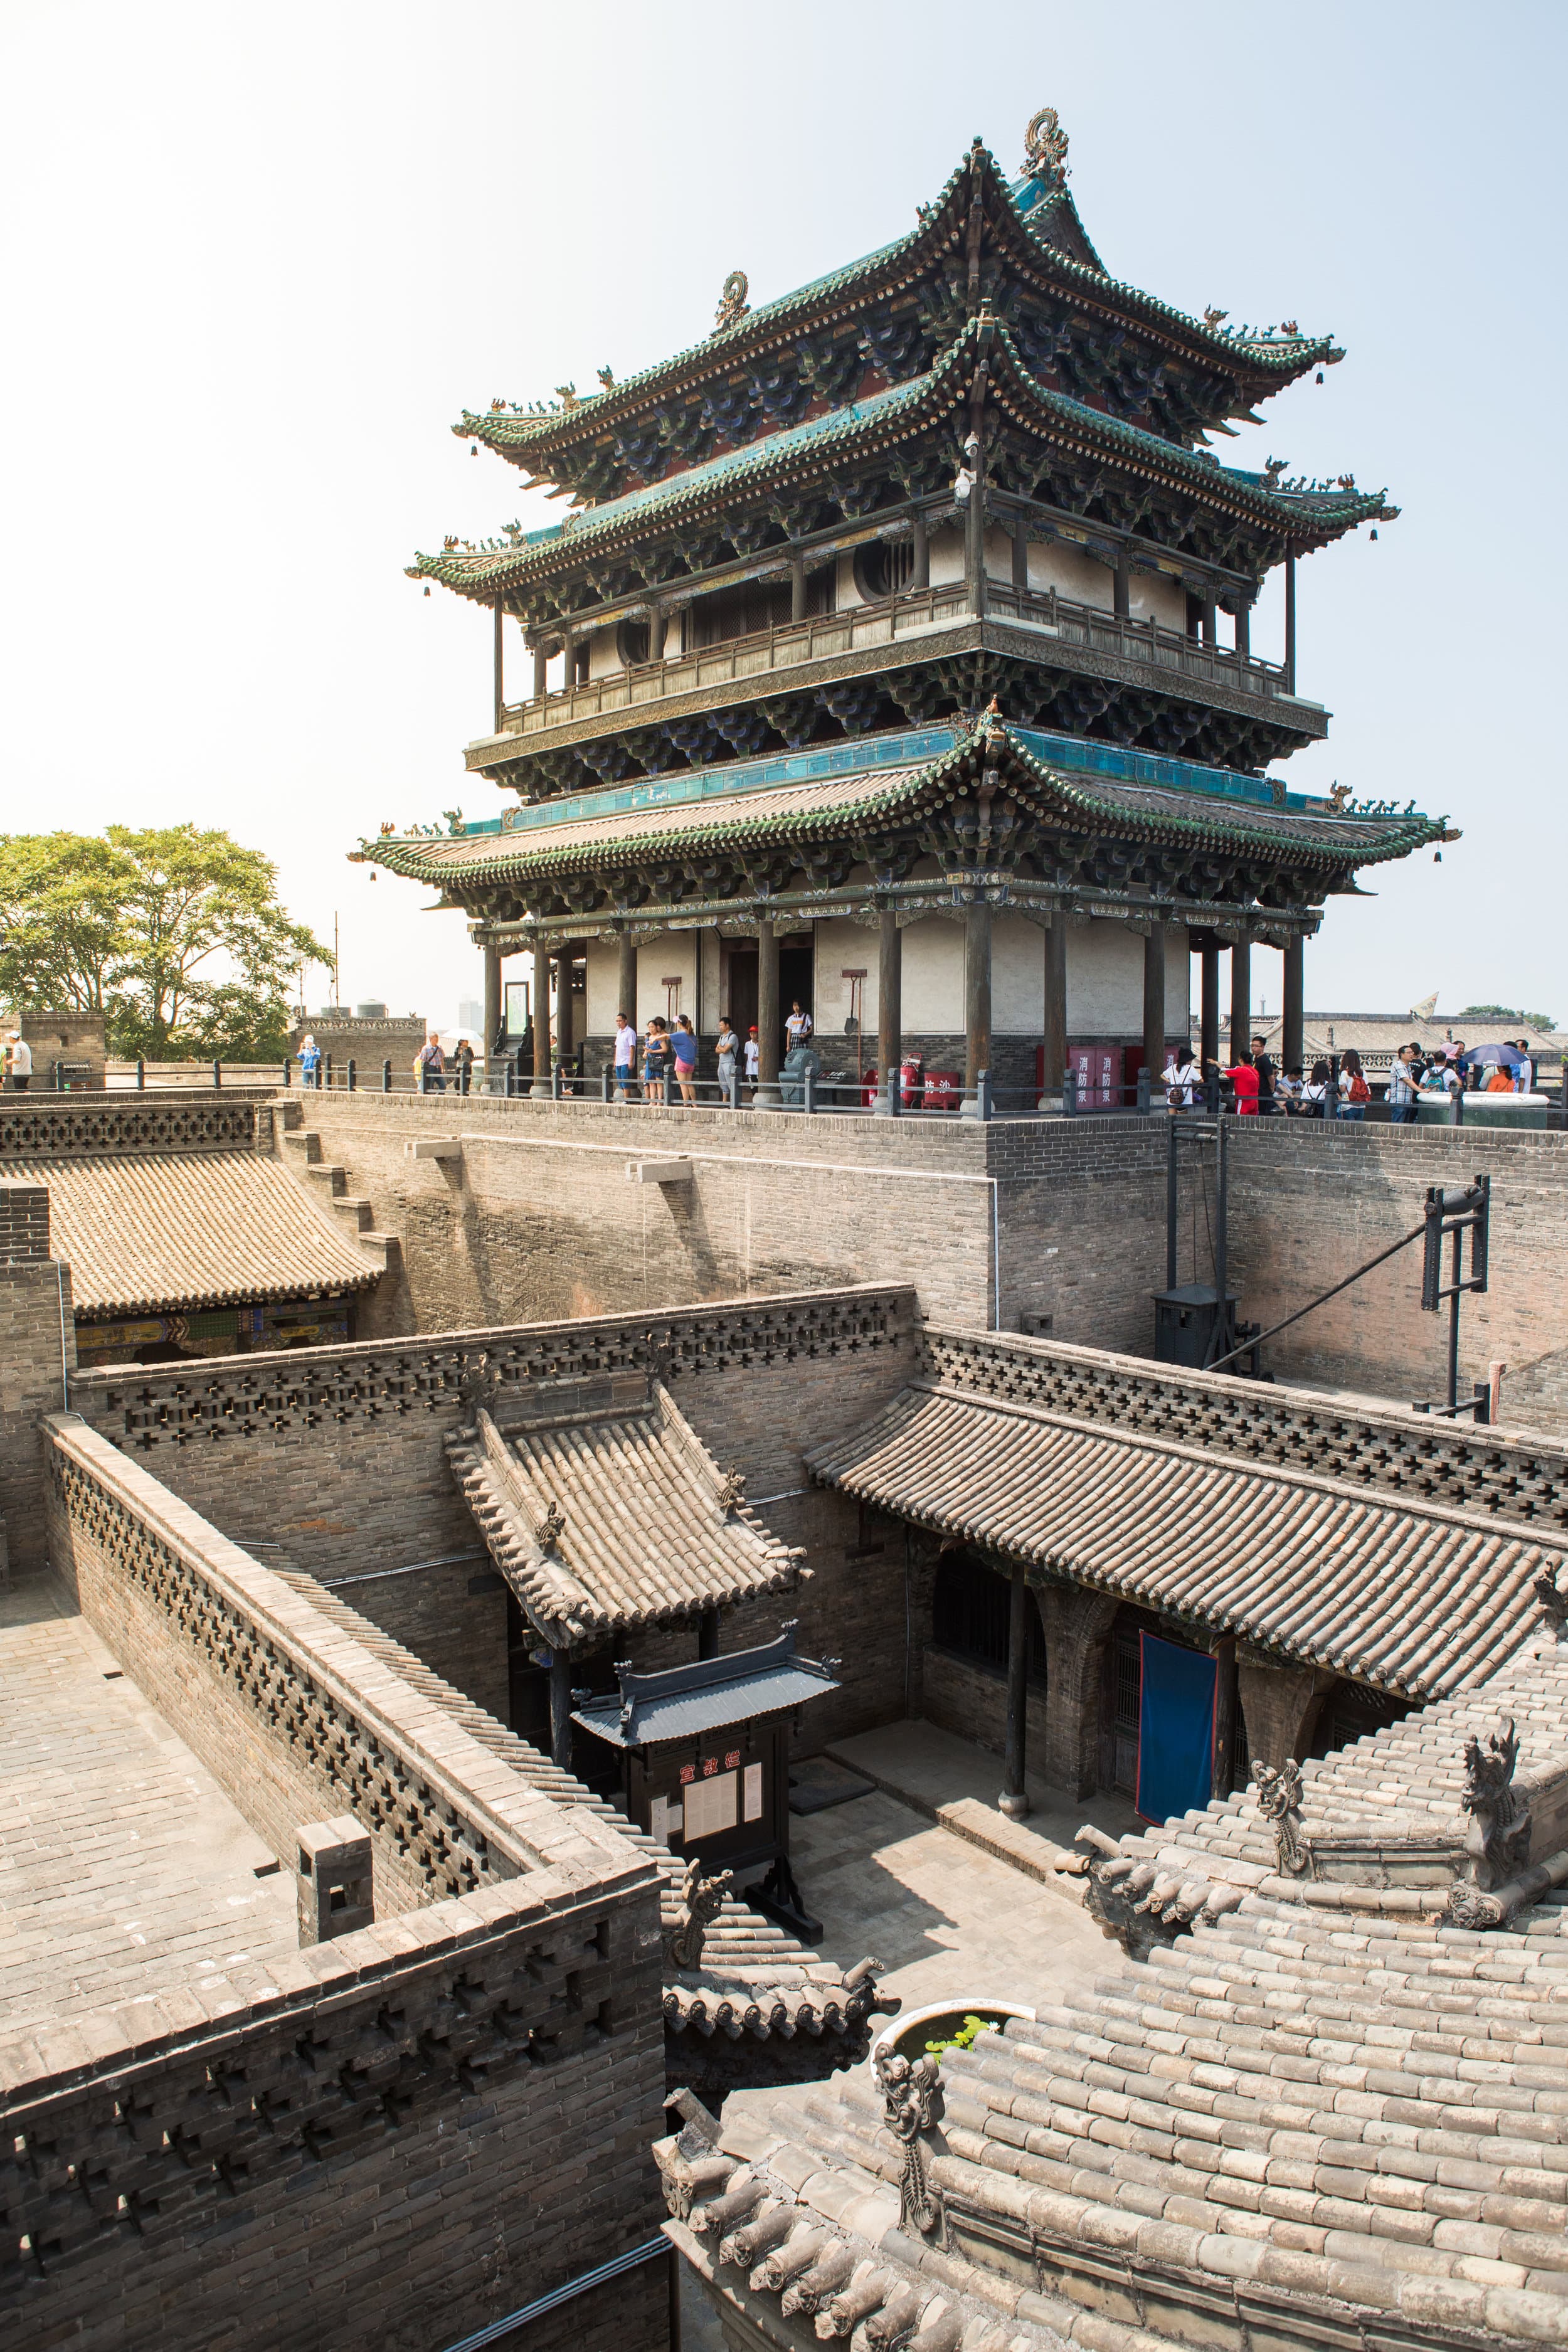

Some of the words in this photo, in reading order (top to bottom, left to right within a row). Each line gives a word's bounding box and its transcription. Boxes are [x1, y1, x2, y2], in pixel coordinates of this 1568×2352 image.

[1078, 1056, 1088, 1103] 消防泵
[1102, 1056, 1111, 1103] 消防泵
[679, 1749, 741, 1784] 宣教栏
